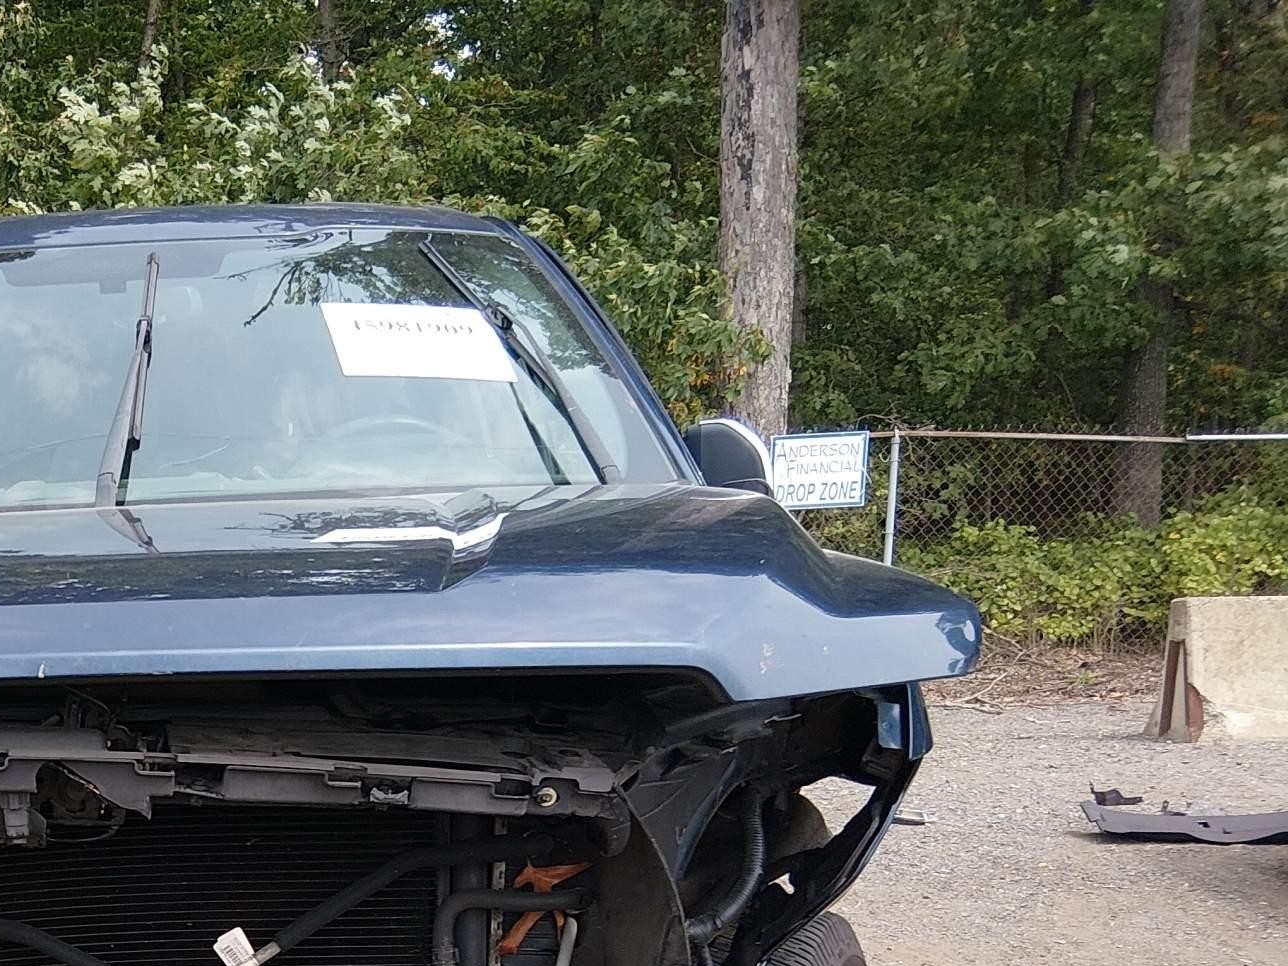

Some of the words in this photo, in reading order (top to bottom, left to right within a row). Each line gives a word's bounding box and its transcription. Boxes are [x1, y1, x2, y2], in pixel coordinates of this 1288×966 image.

[776, 442, 860, 461] ANDERSON
[786, 460, 859, 478] FINANCIAL
[775, 483, 816, 503] DROP
[819, 481, 859, 501] ZONE
